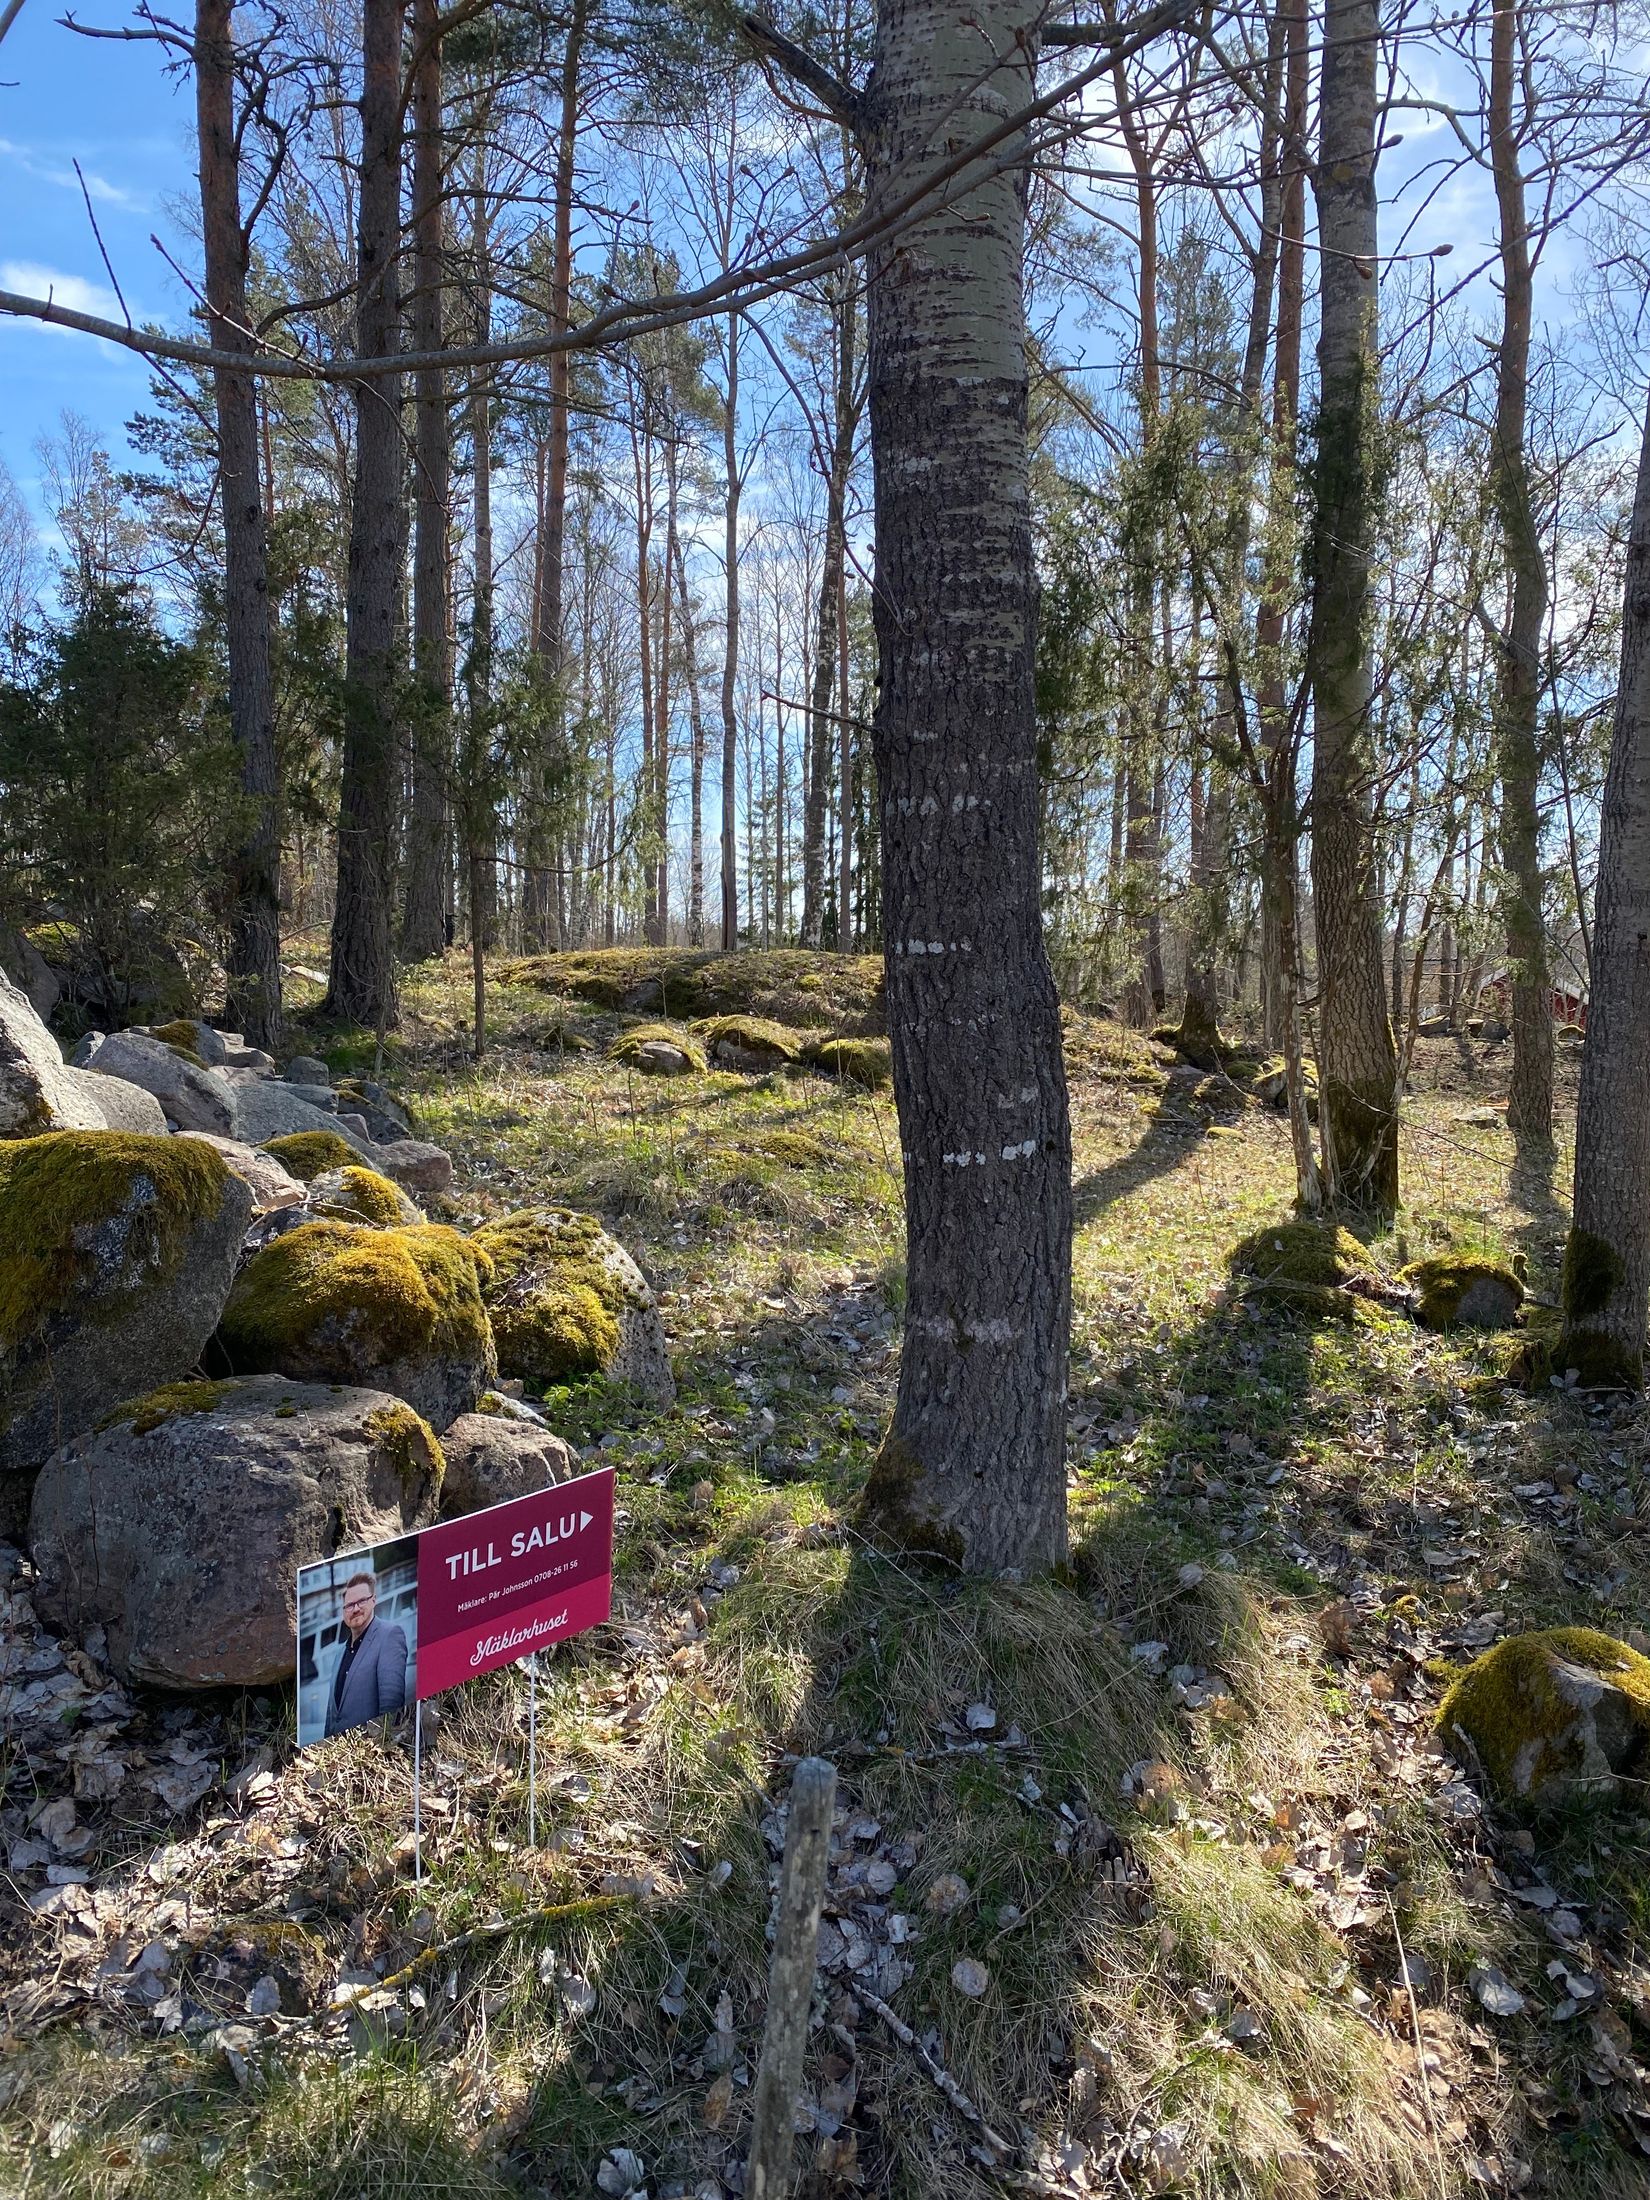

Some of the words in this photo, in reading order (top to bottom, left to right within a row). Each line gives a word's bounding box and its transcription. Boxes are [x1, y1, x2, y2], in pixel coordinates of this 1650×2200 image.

[445, 1542, 502, 1580] TILL
[510, 1513, 576, 1557] SALU
[457, 1596, 487, 1613] Mäklare:
[488, 1590, 500, 1601] Pär
[501, 1578, 533, 1596] Johnsson
[533, 1565, 562, 1584] 0708-26
[563, 1562, 569, 1572] 11
[569, 1559, 579, 1569] 56
[469, 1608, 569, 1667] Mäklarhuset
